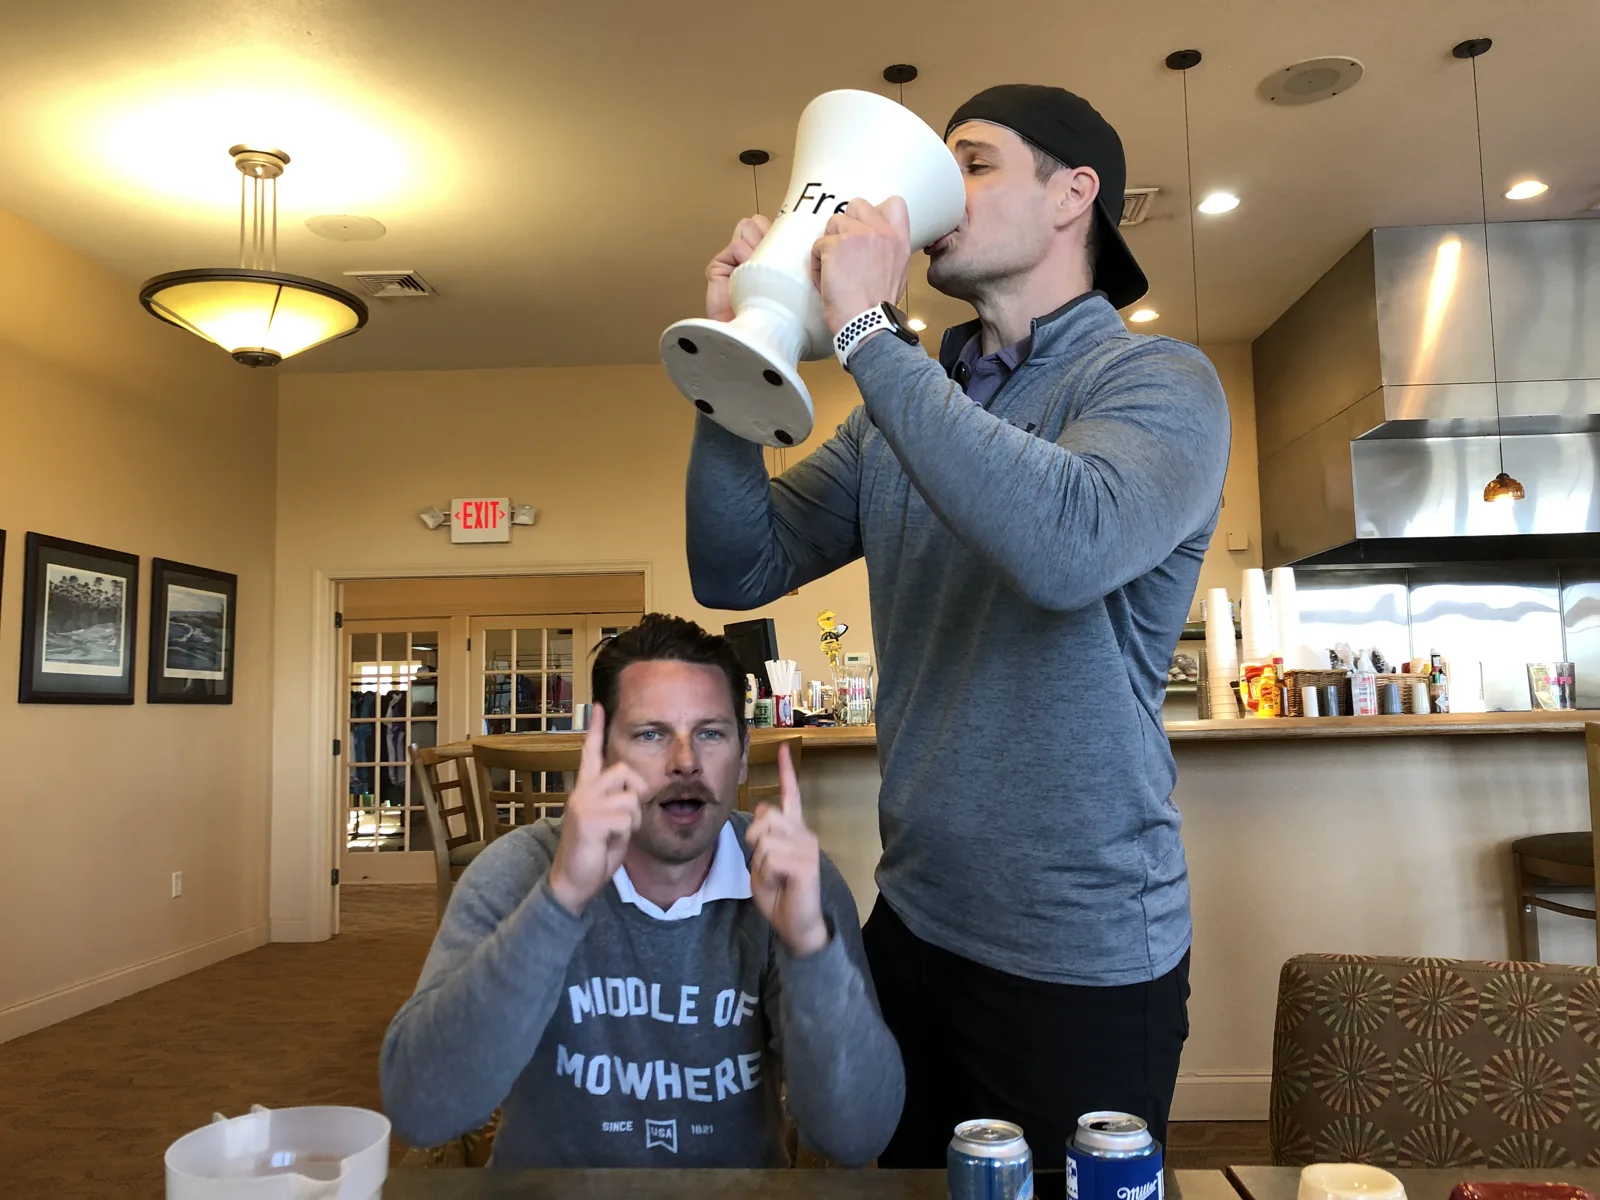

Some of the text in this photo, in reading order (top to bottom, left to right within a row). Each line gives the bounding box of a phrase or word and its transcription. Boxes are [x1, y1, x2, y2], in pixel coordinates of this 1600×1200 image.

[462, 501, 499, 529] EXIT
[568, 976, 759, 1027] MIDDLE OF
[556, 1044, 763, 1102] MOWHERE
[602, 1120, 634, 1132] SINCE
[650, 1126, 673, 1139] USA
[1117, 1179, 1158, 1200] Miller
